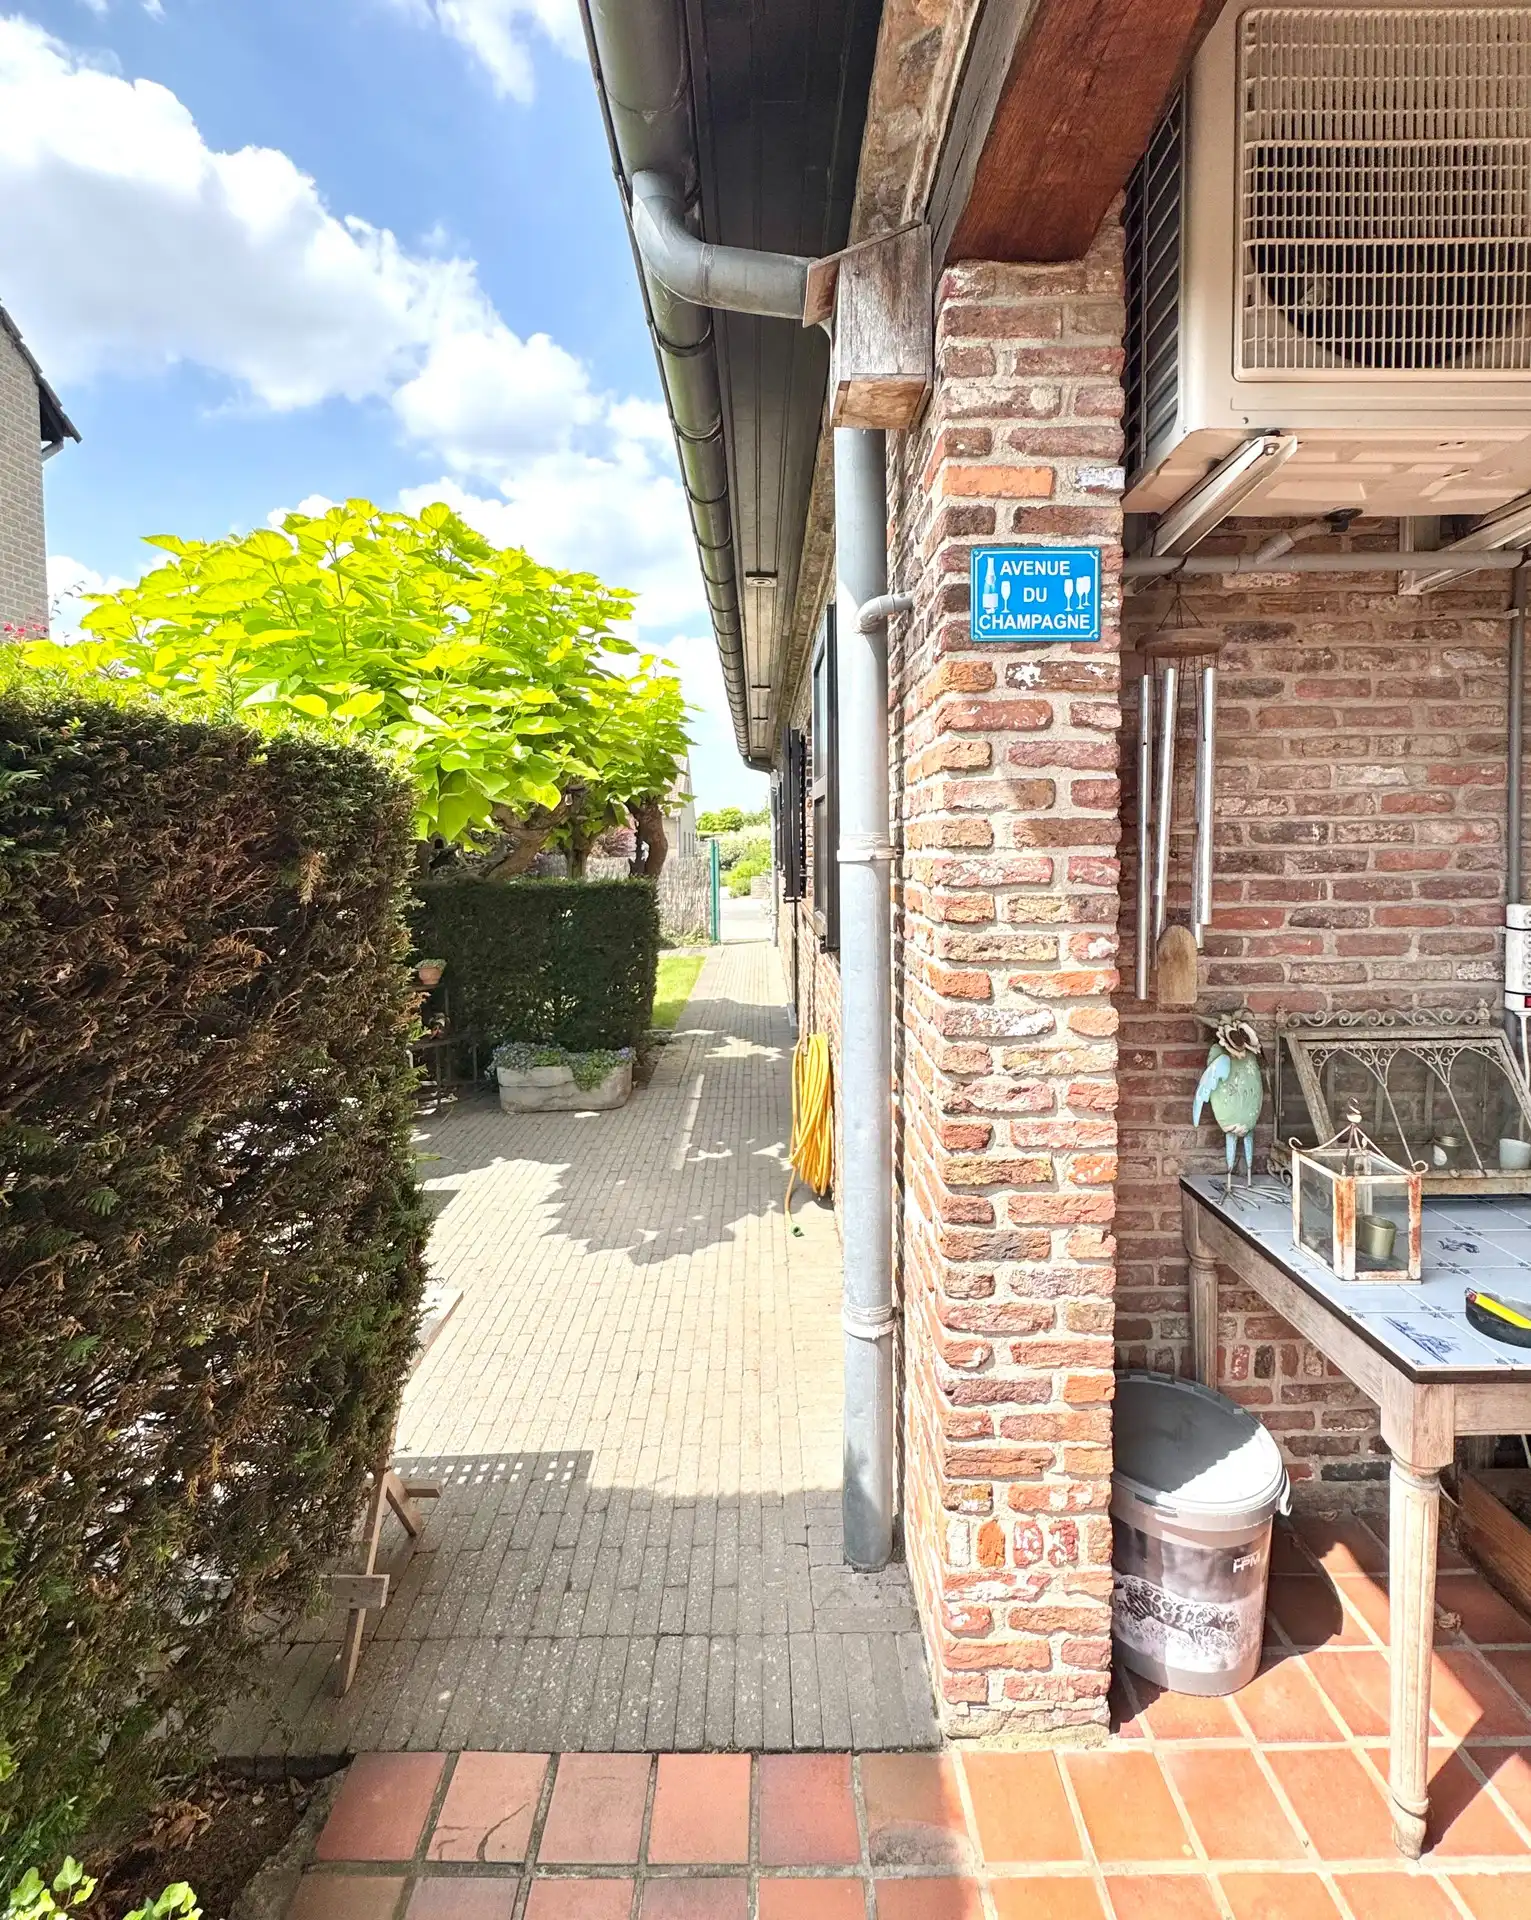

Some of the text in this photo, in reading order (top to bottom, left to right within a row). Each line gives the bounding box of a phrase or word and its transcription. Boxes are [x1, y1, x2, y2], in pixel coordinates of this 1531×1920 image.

[999, 560, 1071, 576] AVENUE
[1023, 587, 1048, 603] DU
[979, 614, 1091, 630] CHAMPAGNE
